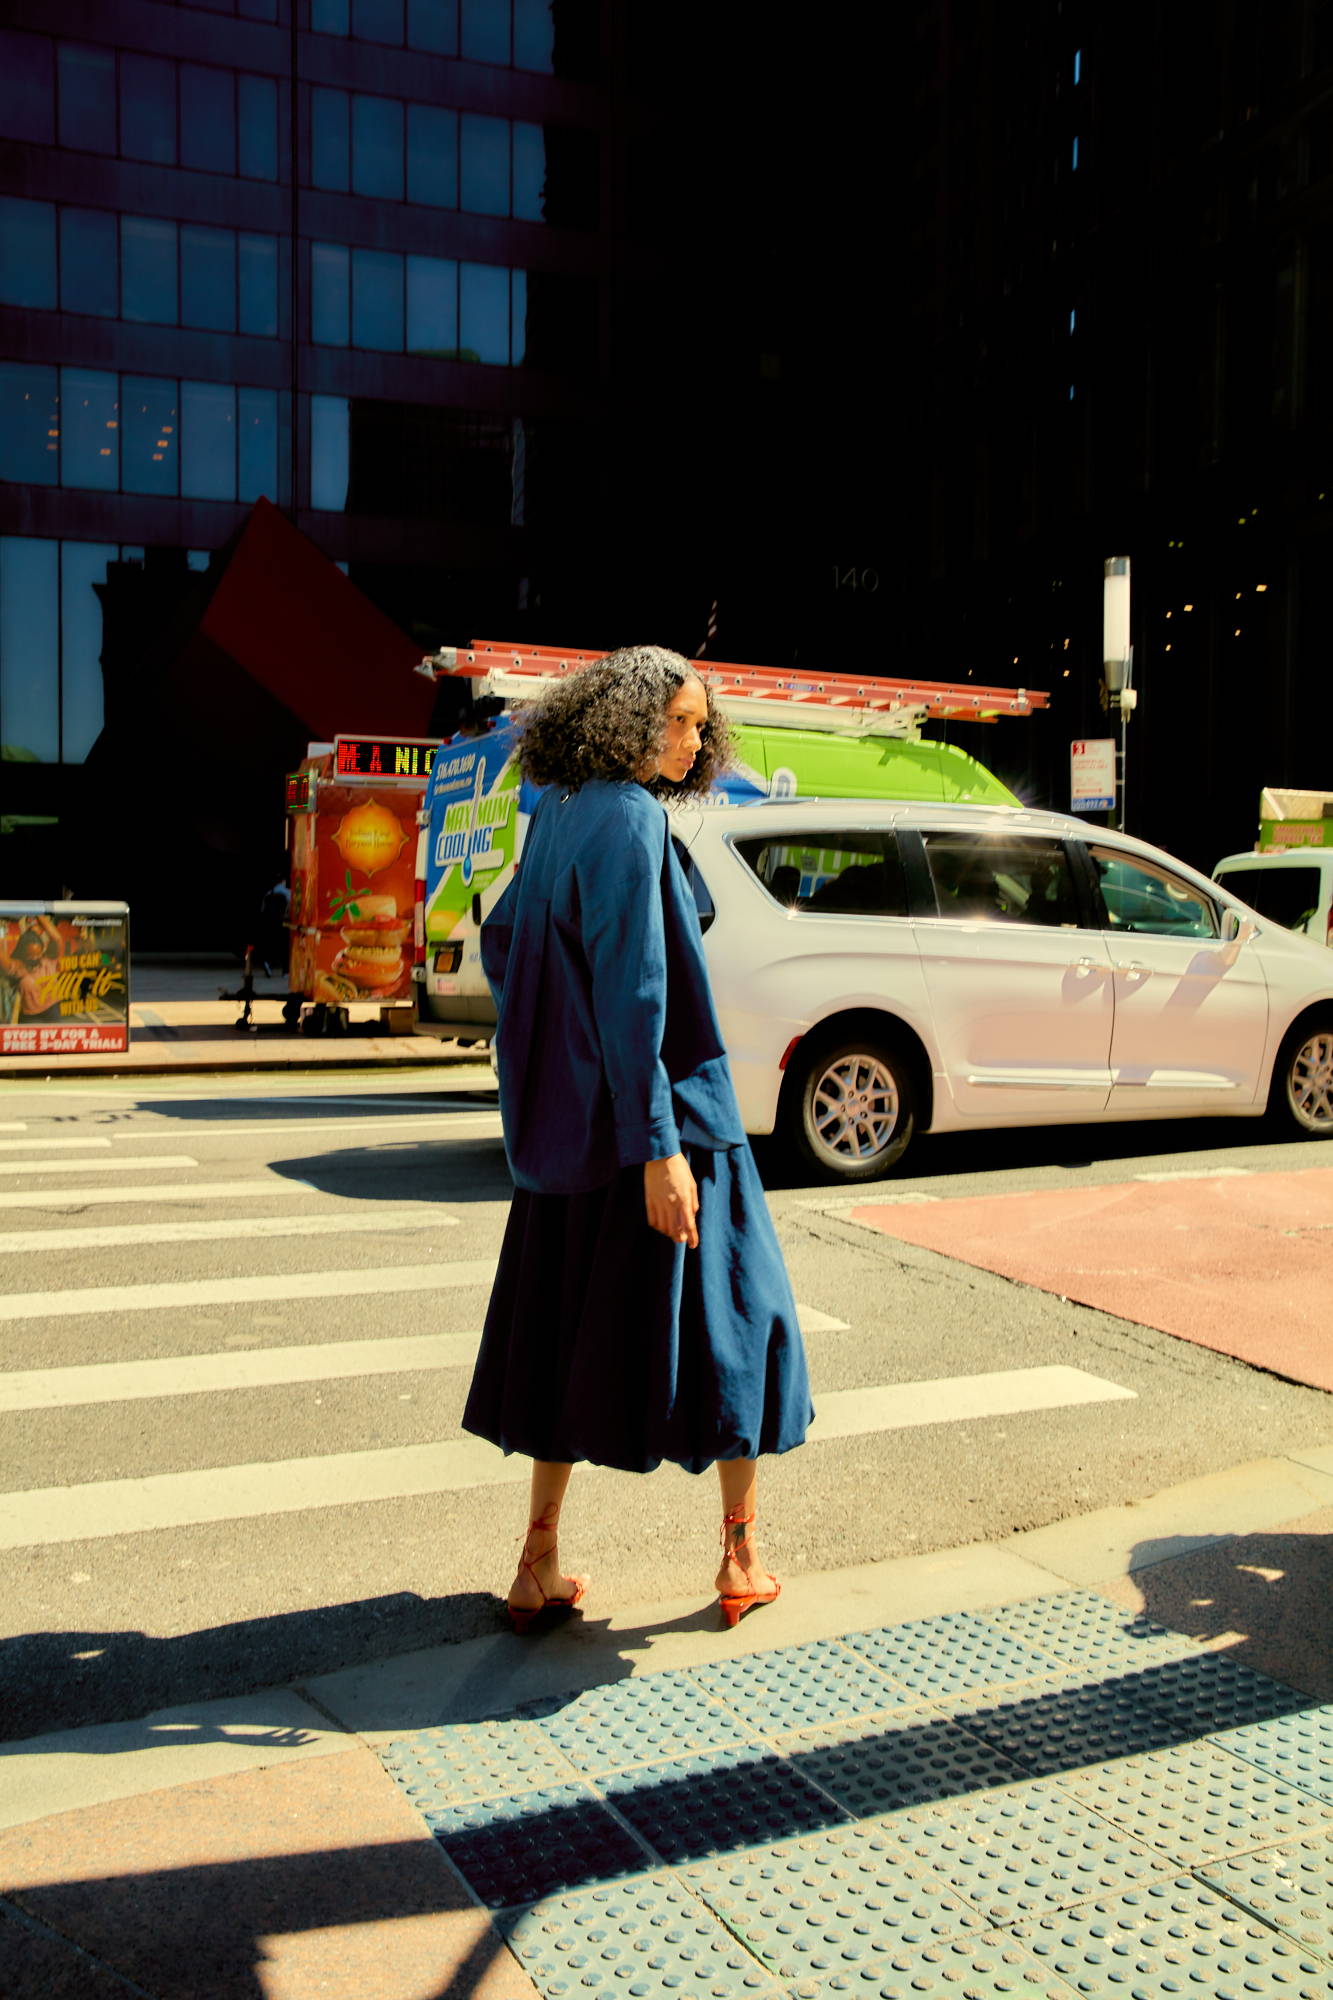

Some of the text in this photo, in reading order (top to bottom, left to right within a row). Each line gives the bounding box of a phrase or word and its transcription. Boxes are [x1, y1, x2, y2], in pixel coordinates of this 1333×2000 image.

[832, 565, 879, 592] 140
[369, 745, 382, 772] A
[437, 827, 492, 861] COOLING
[60, 952, 101, 971] YOU CAN
[3, 1028, 100, 1041] STOP BY FOR A
[3, 1040, 37, 1052] FREE
[82, 1038, 123, 1050] TRIAL!
